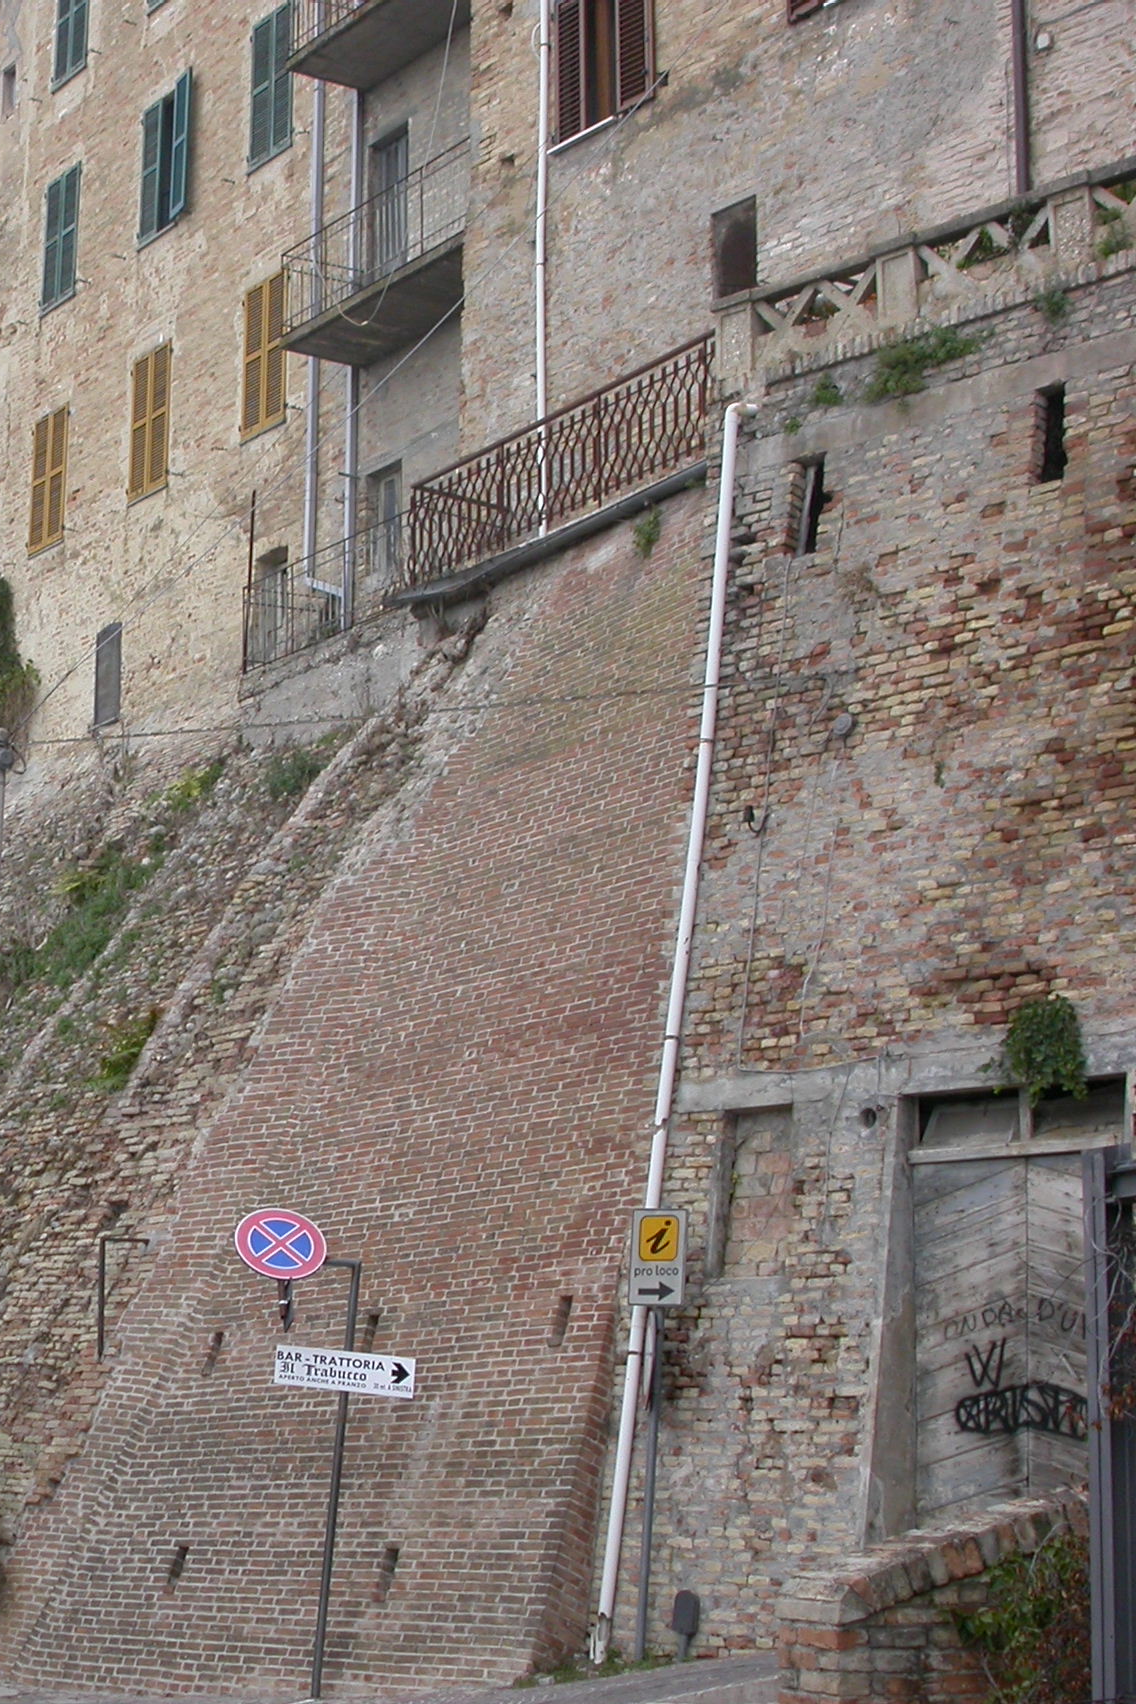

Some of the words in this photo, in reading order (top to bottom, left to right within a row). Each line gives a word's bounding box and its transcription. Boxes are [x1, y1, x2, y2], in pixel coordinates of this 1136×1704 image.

[634, 1266, 653, 1278] pro
[655, 1265, 679, 1276] loco
[277, 1350, 302, 1362] BAR
[312, 1354, 385, 1371] TRATTORIA
[303, 1363, 367, 1381] Trabucco
[338, 1381, 367, 1389] PRANZO
